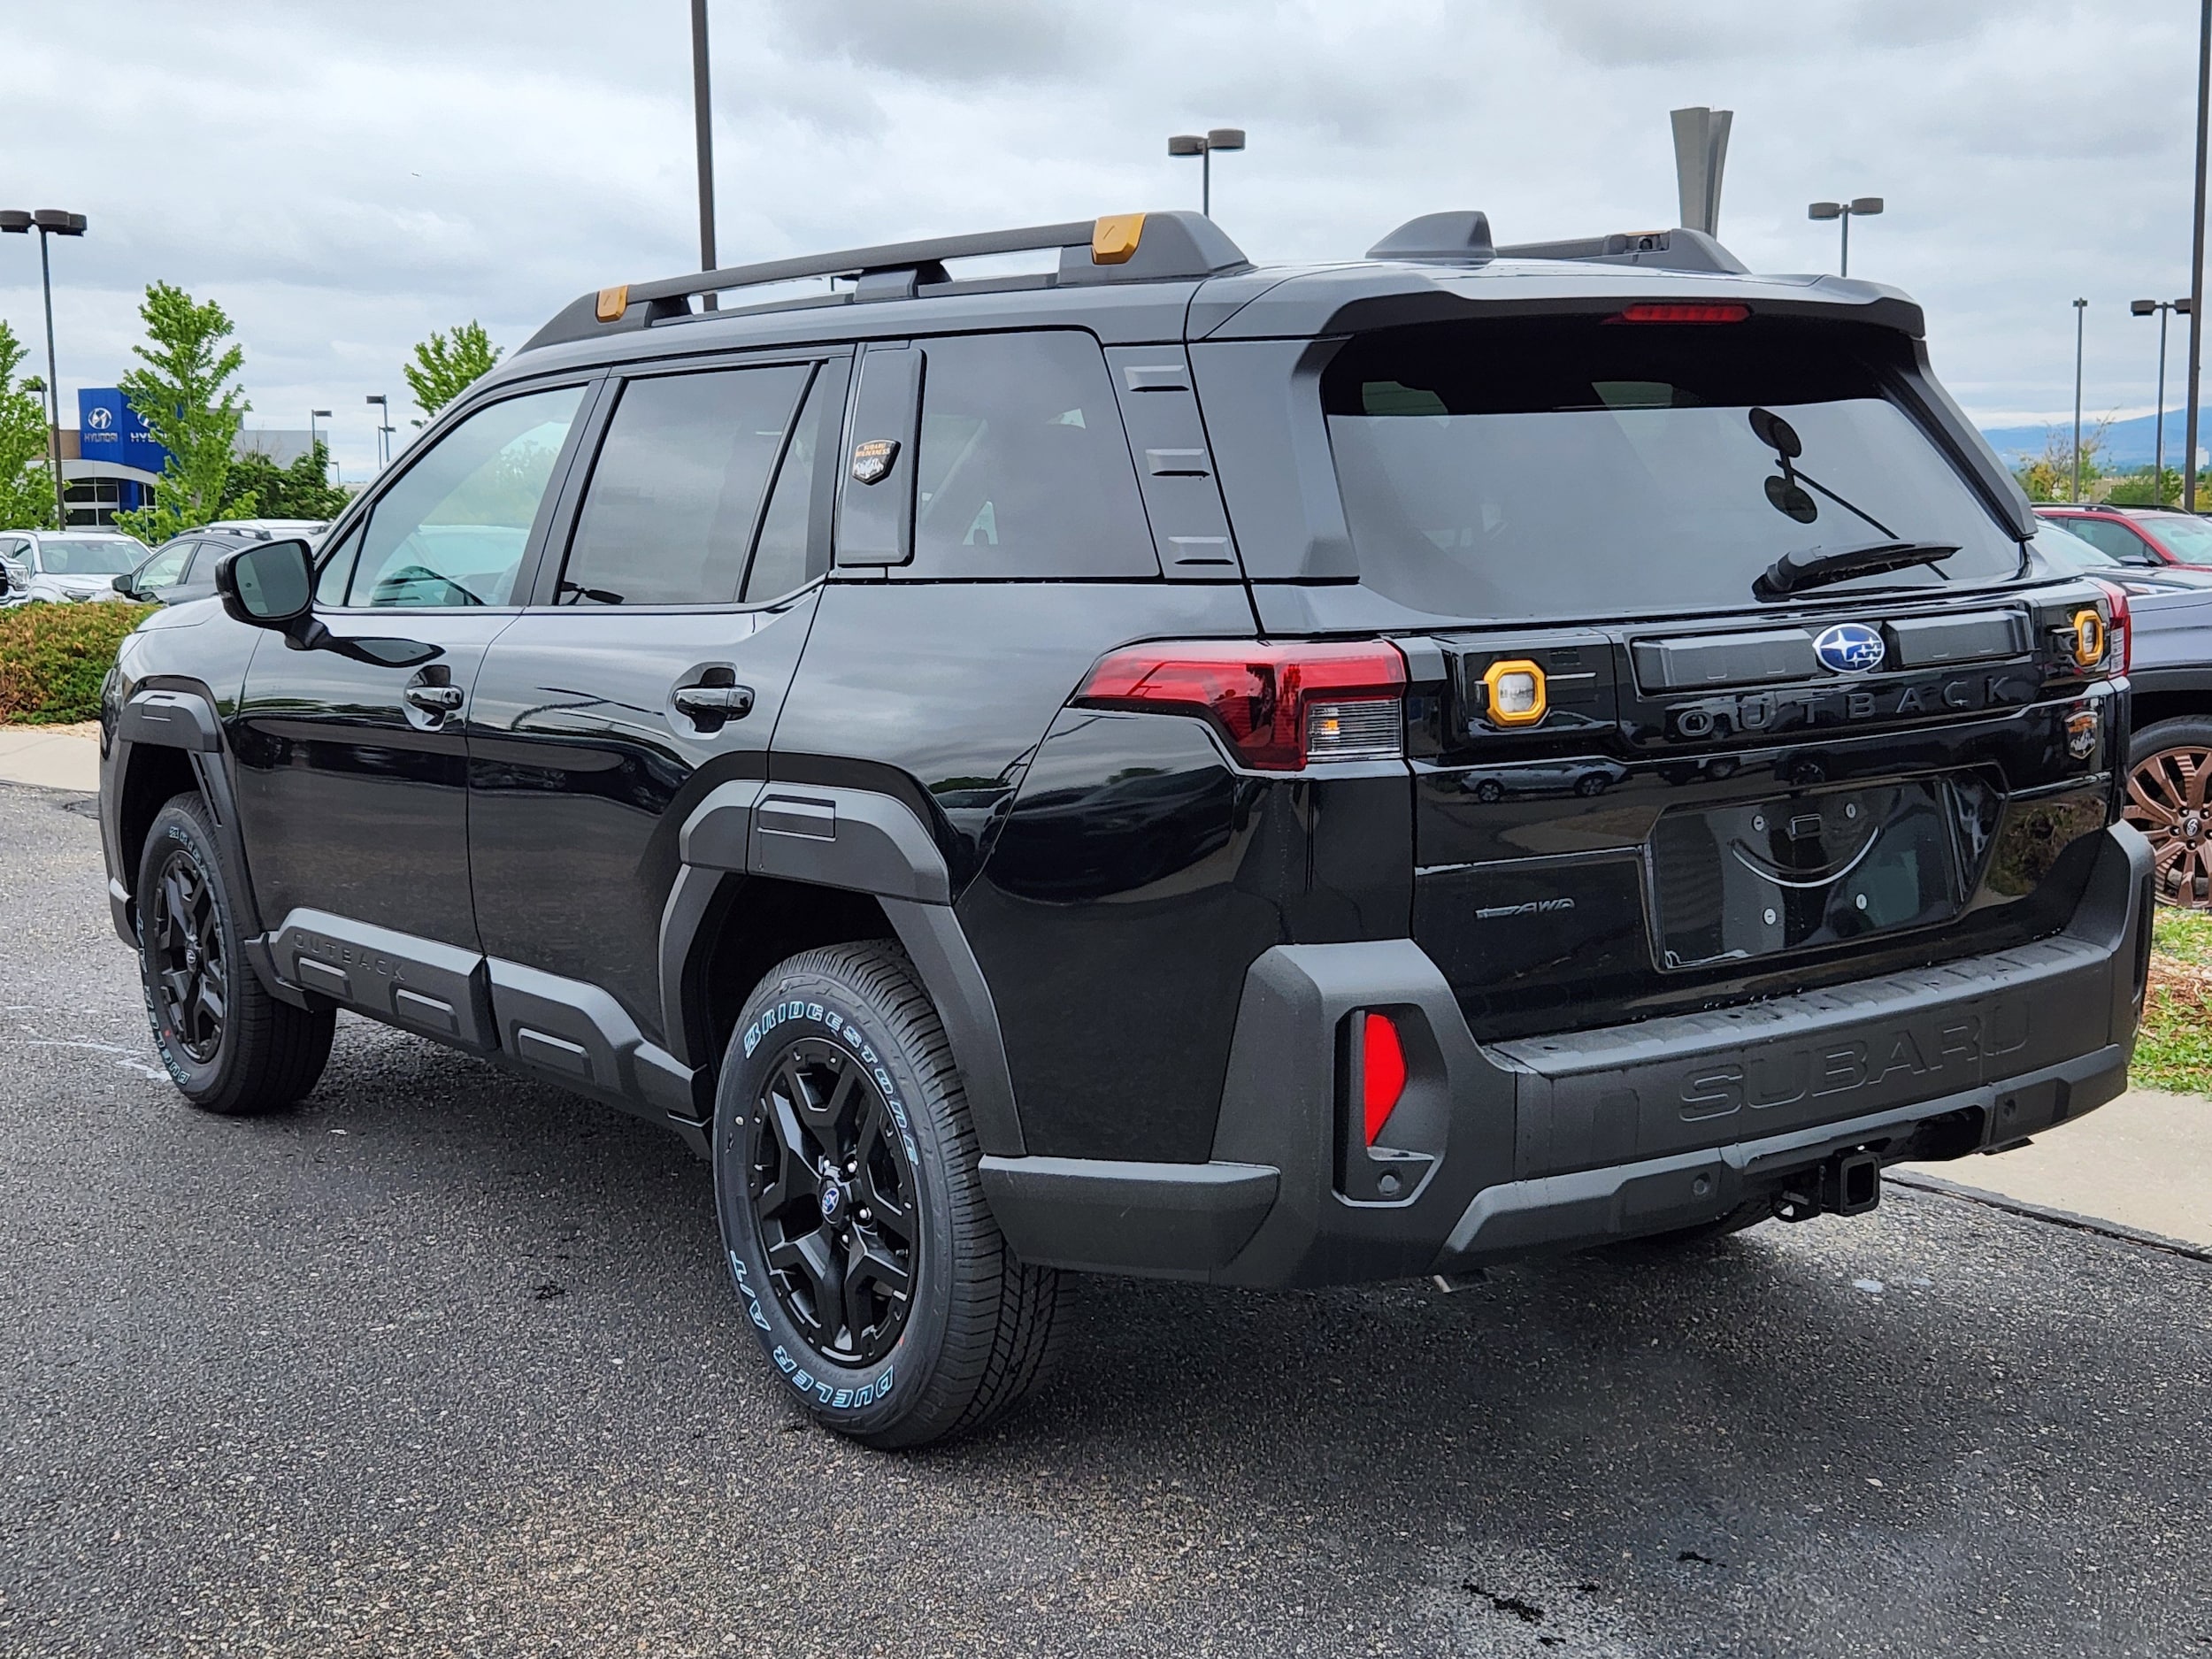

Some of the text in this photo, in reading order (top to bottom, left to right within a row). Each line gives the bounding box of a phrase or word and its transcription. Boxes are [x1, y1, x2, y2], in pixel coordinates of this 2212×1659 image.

[84, 432, 119, 442] HYUNDAI
[1677, 675, 2011, 738] OUTBACK
[1514, 897, 1575, 916] AWD
[293, 933, 406, 981] OUTBACK
[743, 1000, 919, 1166] BRIDGESTONE
[1679, 1002, 2032, 1122] SUBARU
[729, 1249, 895, 1409] DUELER A/T
